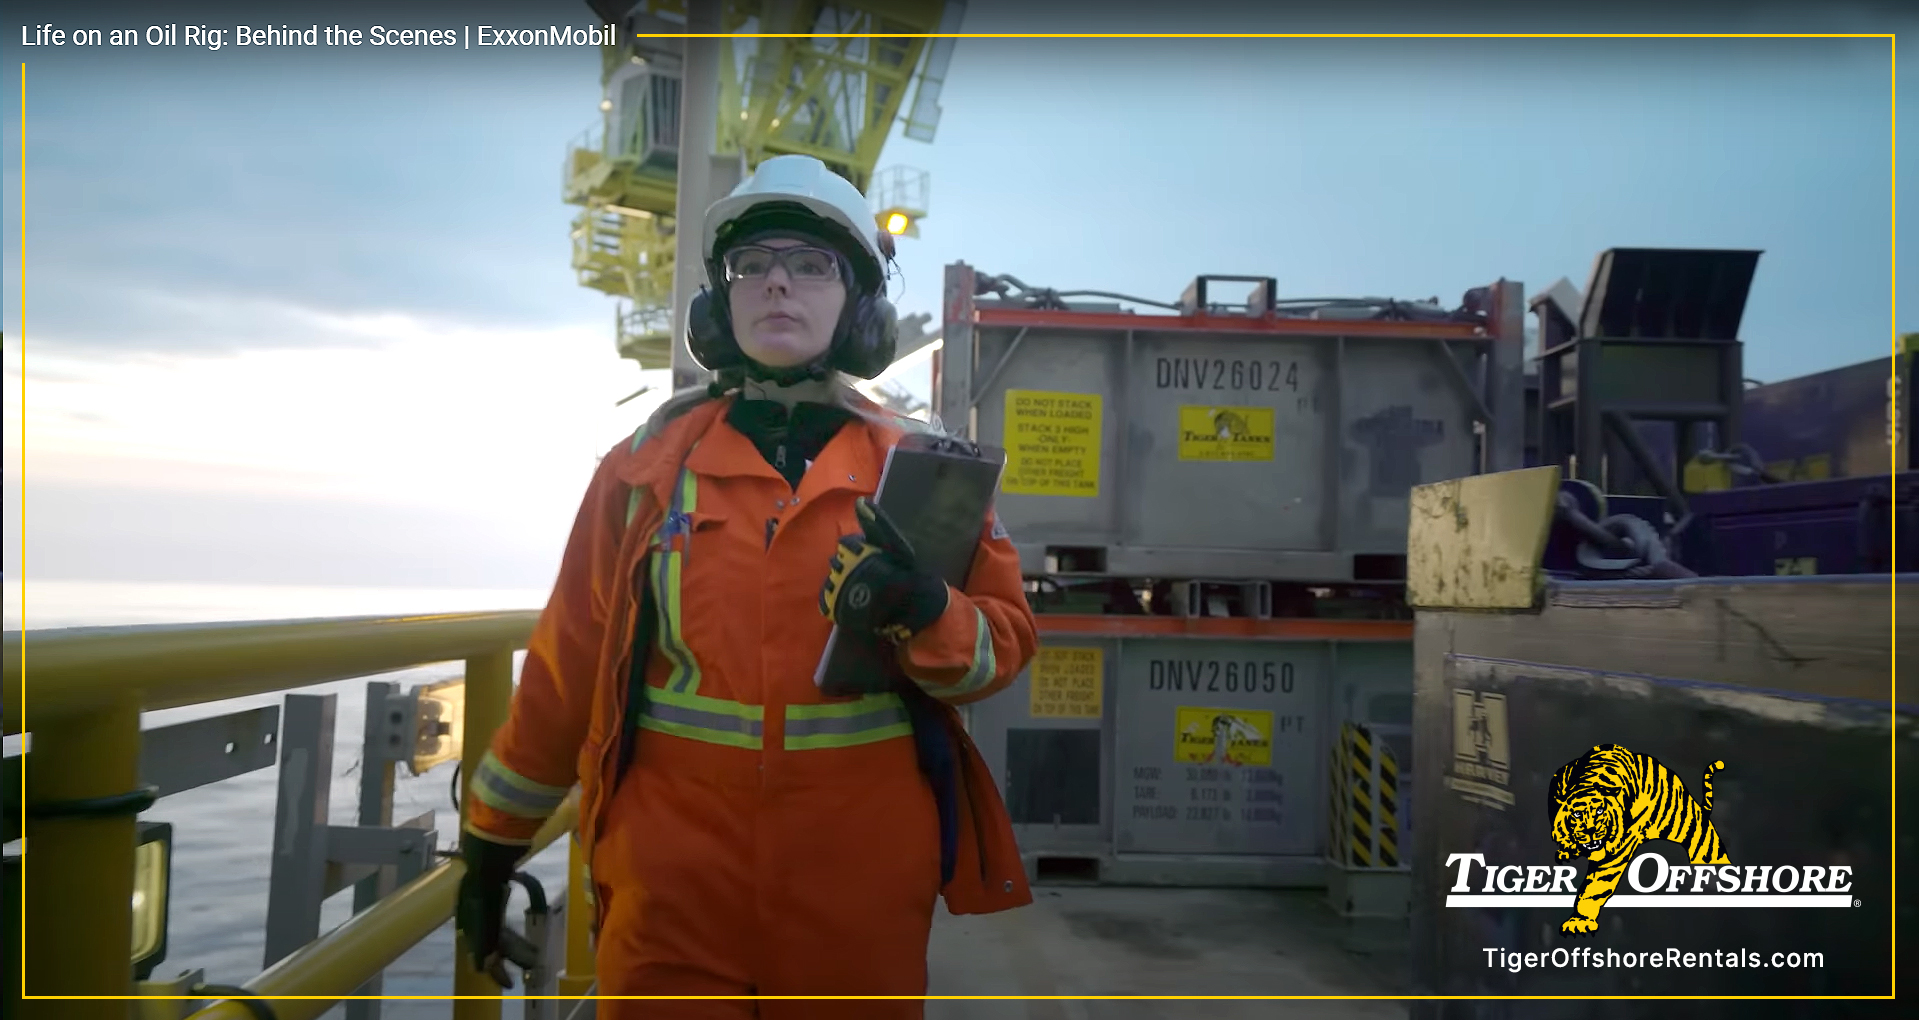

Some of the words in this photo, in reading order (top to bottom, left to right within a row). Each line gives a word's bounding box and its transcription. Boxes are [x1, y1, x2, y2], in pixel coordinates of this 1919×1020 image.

[1157, 358, 1298, 392] DNV26024
[1016, 398, 1031, 406] DO
[1033, 398, 1055, 407] NOT
[1058, 399, 1092, 409] STACK
[1016, 408, 1047, 417] WHEN
[1049, 410, 1092, 420] LOADED
[1018, 422, 1051, 433] STACK
[1063, 425, 1089, 435] HIGH
[1018, 444, 1049, 453] WHEN
[1052, 445, 1086, 454] EMPTY
[1150, 660, 1294, 693] DNV26050
